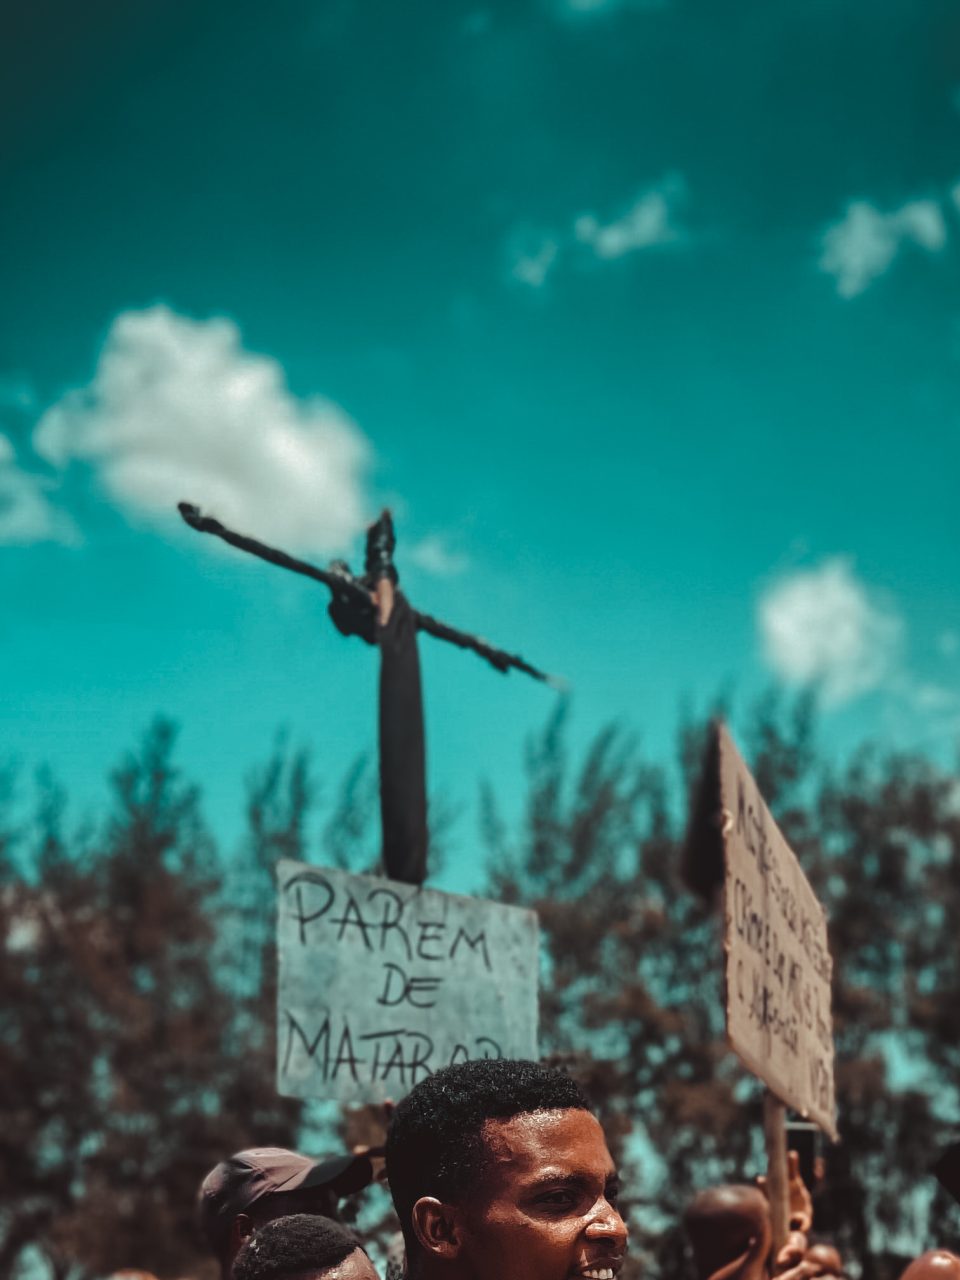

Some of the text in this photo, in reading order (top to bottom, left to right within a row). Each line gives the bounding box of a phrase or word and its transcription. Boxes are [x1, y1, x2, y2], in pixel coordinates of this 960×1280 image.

[283, 872, 493, 973] PAREM
[377, 962, 444, 1008] DE
[282, 1008, 434, 1087] MATAR
